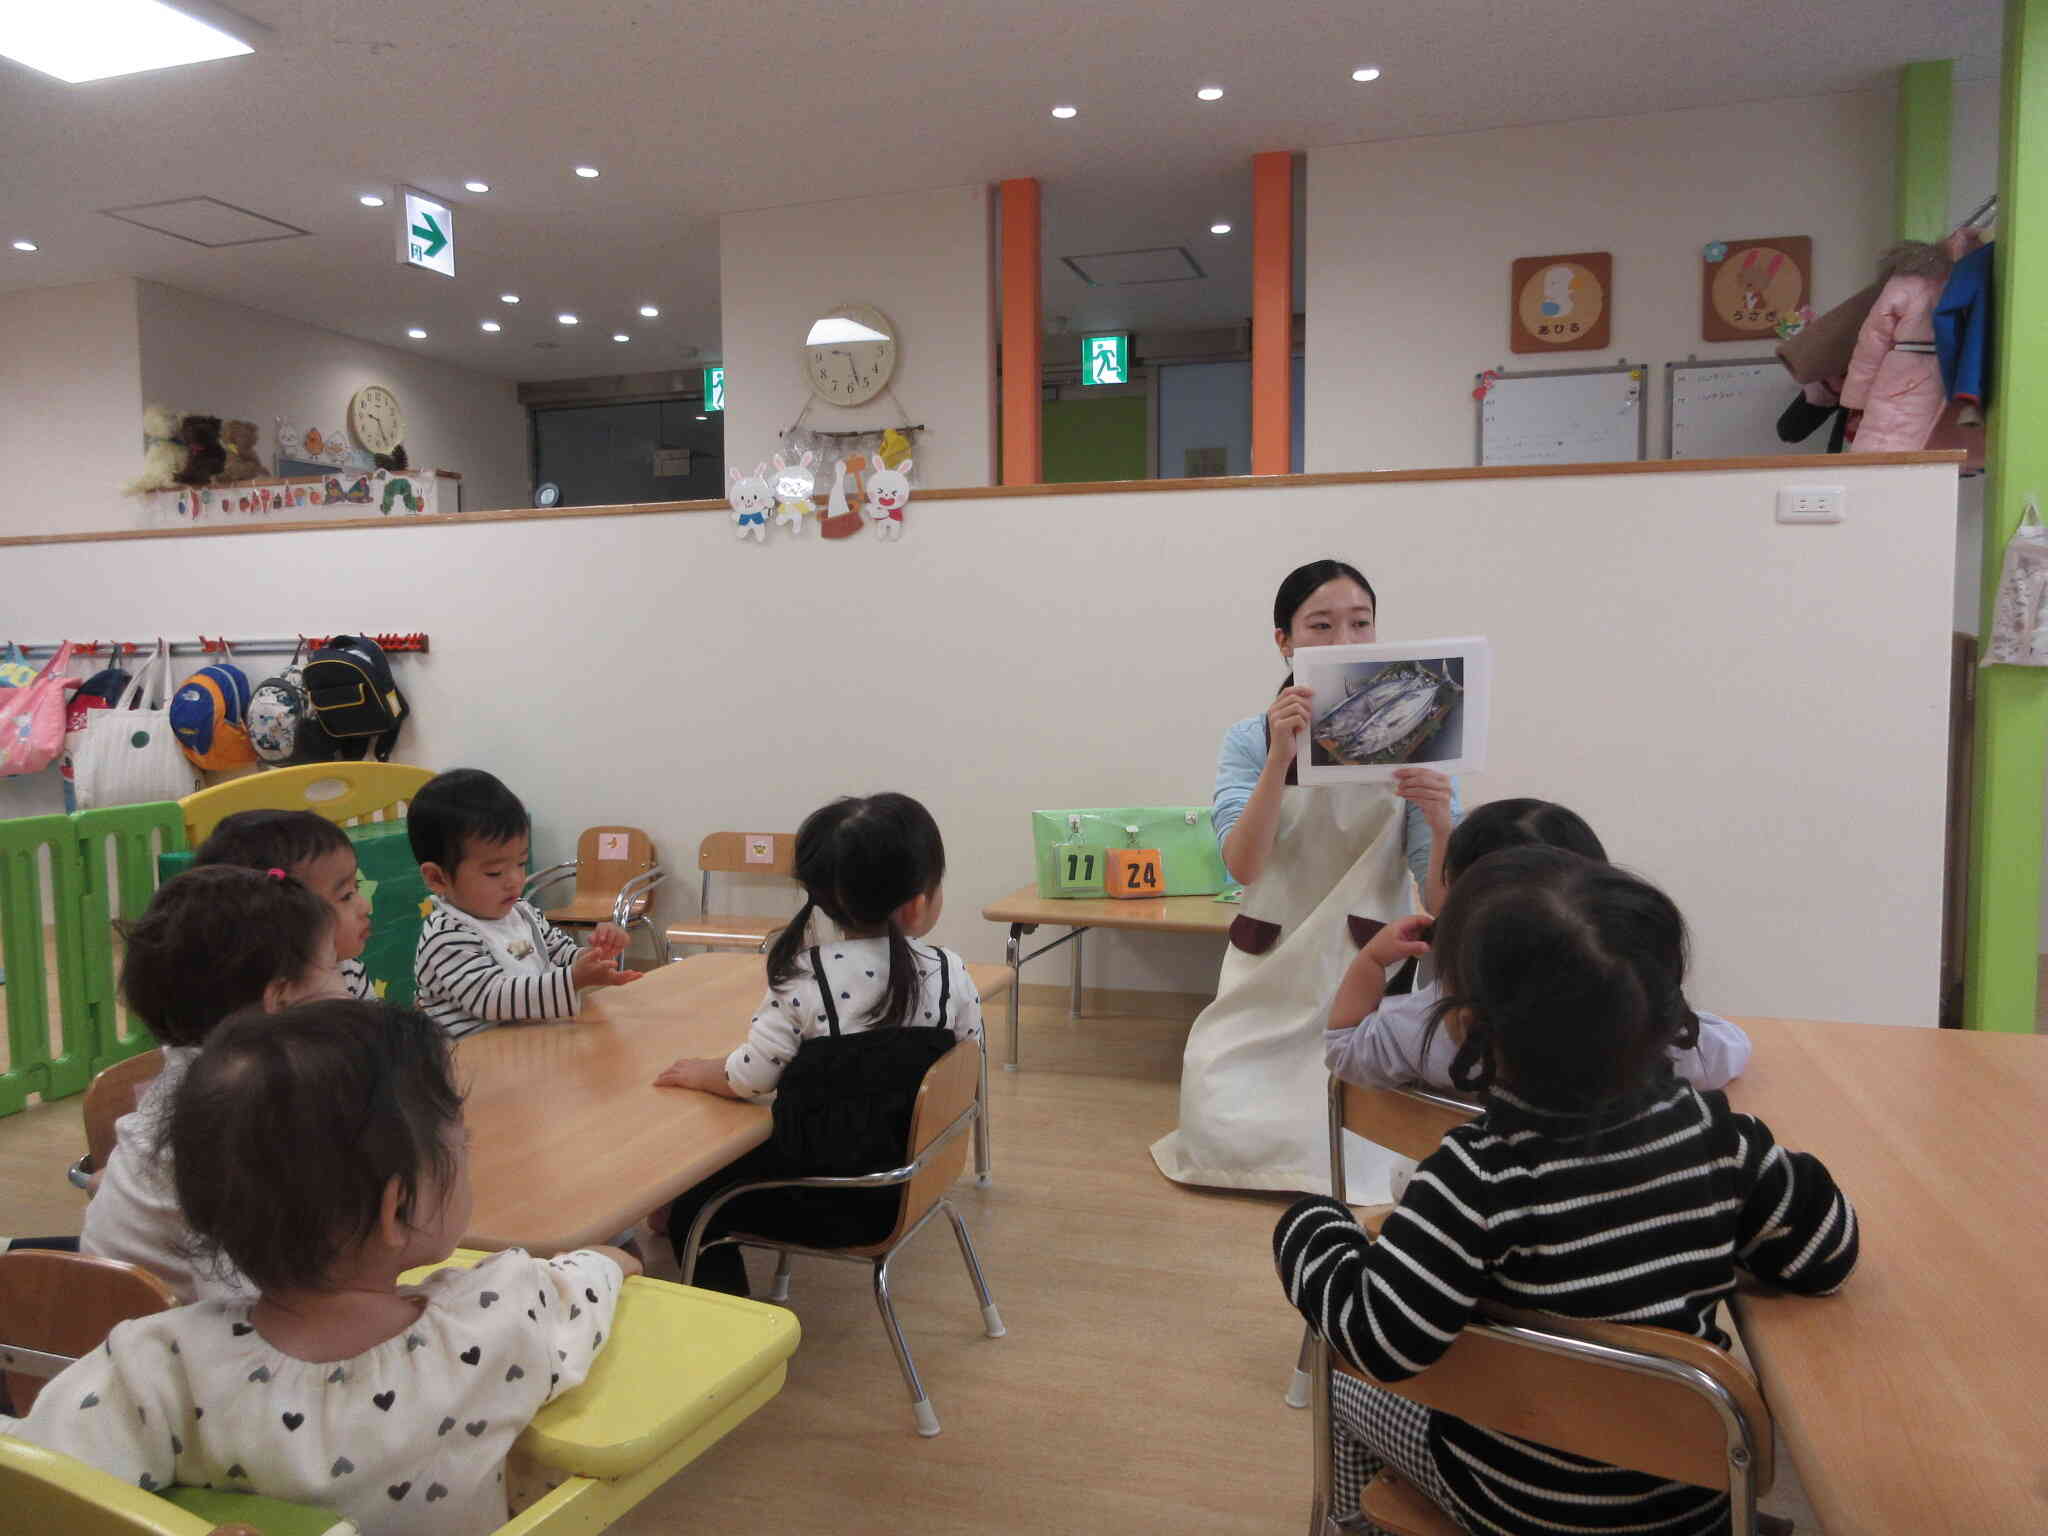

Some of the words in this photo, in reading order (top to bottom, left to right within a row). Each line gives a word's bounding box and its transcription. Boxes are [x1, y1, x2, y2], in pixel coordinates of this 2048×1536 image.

[1733, 310, 1777, 322] うさぎ
[1538, 322, 1580, 336] あひる
[1067, 854, 1095, 881] 11
[1127, 862, 1157, 889] 24
